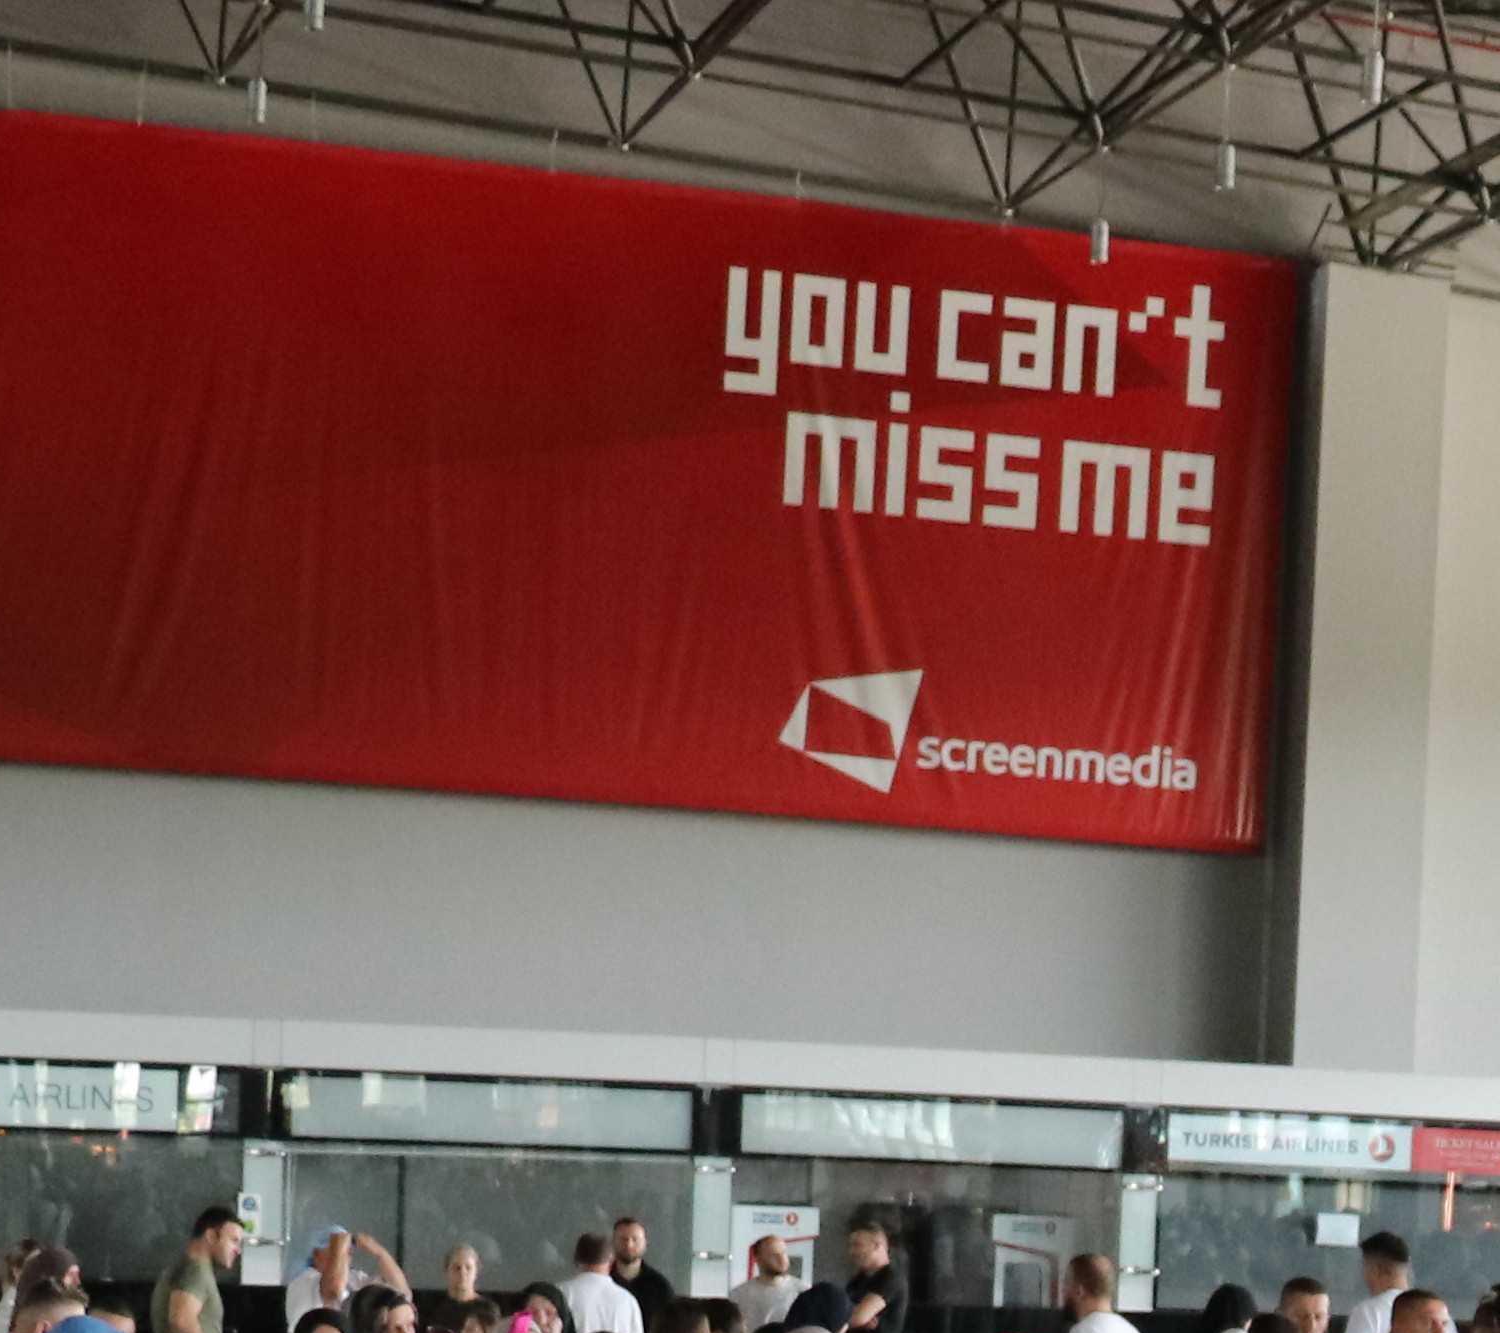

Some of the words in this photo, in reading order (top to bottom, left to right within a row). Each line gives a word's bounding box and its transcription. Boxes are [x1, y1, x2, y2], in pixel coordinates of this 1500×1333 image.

[722, 266, 912, 396] you
[936, 284, 1225, 410] can't
[783, 391, 1041, 531] miss
[1059, 439, 1215, 547] me
[916, 736, 1198, 792] screenmedia
